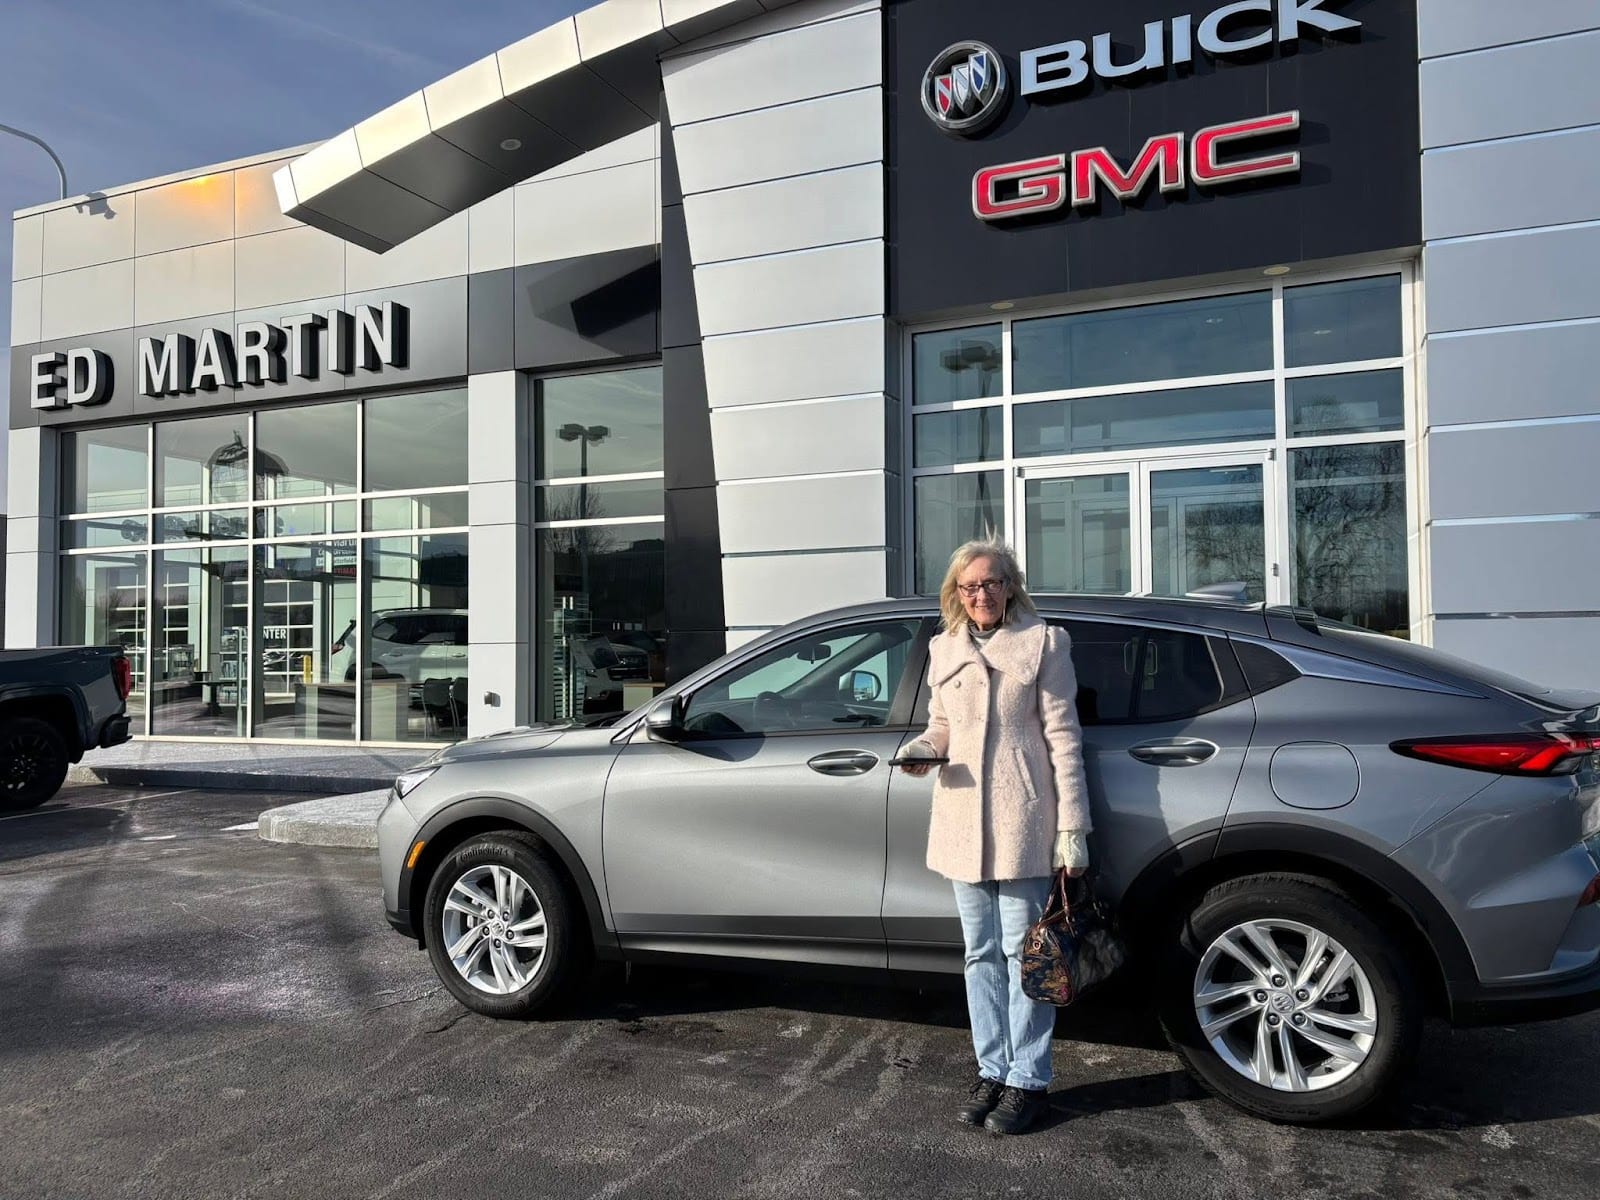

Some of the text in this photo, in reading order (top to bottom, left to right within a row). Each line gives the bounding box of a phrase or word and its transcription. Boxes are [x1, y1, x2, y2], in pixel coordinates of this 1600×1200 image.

[1020, 0, 1362, 96] BUICK
[972, 110, 1300, 221] GMC
[30, 300, 395, 409] ED MARTIN
[263, 628, 287, 639] NTER
